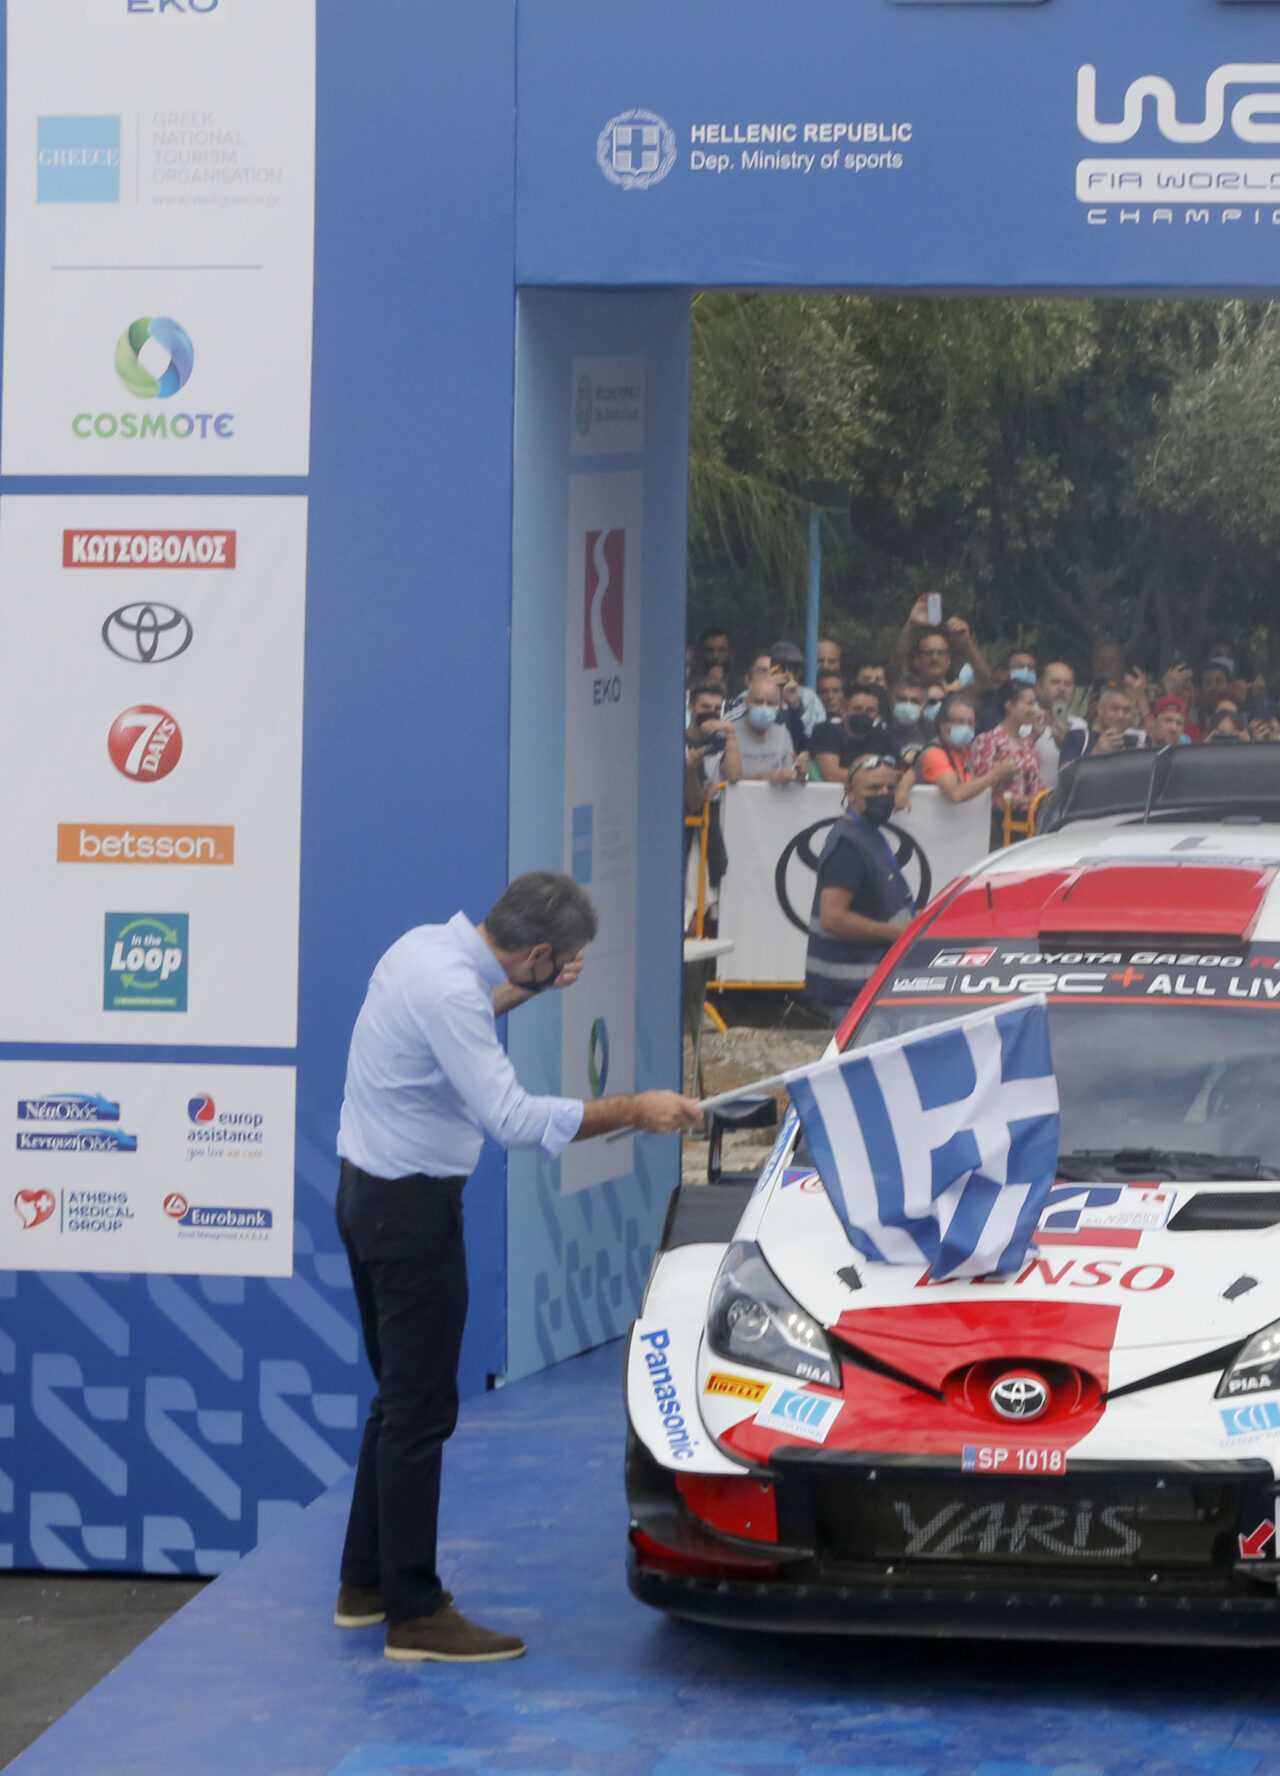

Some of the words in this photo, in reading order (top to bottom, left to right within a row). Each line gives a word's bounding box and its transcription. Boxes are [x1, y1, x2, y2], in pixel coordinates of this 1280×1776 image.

[126, 0, 219, 14] EKO
[153, 112, 214, 128] GREEK
[153, 131, 246, 147] NATIONAL
[691, 124, 797, 144] HELLENIC
[803, 123, 913, 143] REPUBLIC
[38, 149, 119, 166] GREECE
[153, 149, 238, 165] TOURISM
[690, 151, 735, 173] Dep.
[741, 150, 815, 174] Ministry
[820, 149, 841, 170] of
[844, 150, 904, 173] sports
[153, 168, 282, 184] ORGANISATION
[1088, 172, 1142, 189] FIA
[72, 413, 235, 440] COSMOTE
[72, 535, 227, 565] ΚΩΤΣΟΒΟΛΟΣ
[592, 678, 622, 706] EKO
[121, 712, 166, 776] 7
[141, 717, 177, 774] DAYS
[110, 941, 182, 981] Loop
[932, 950, 990, 968] GR
[1000, 952, 1122, 966] TOYOTA
[1129, 951, 1244, 968] GAZOO
[1145, 974, 1217, 997] ALL
[219, 1112, 263, 1126] europ
[187, 1126, 263, 1143] assistance
[68, 1191, 129, 1204] ATHENS
[68, 1205, 135, 1218] MEDICAL
[191, 1208, 266, 1227] Eurobank
[68, 1219, 123, 1232] GROUP
[796, 1361, 832, 1384] PIAA
[707, 1374, 766, 1400] PIRELLI
[1228, 1374, 1273, 1394] PIAA
[640, 1328, 700, 1461] Panasonic
[978, 1447, 1009, 1470] SP
[1016, 1447, 1063, 1472] 1018
